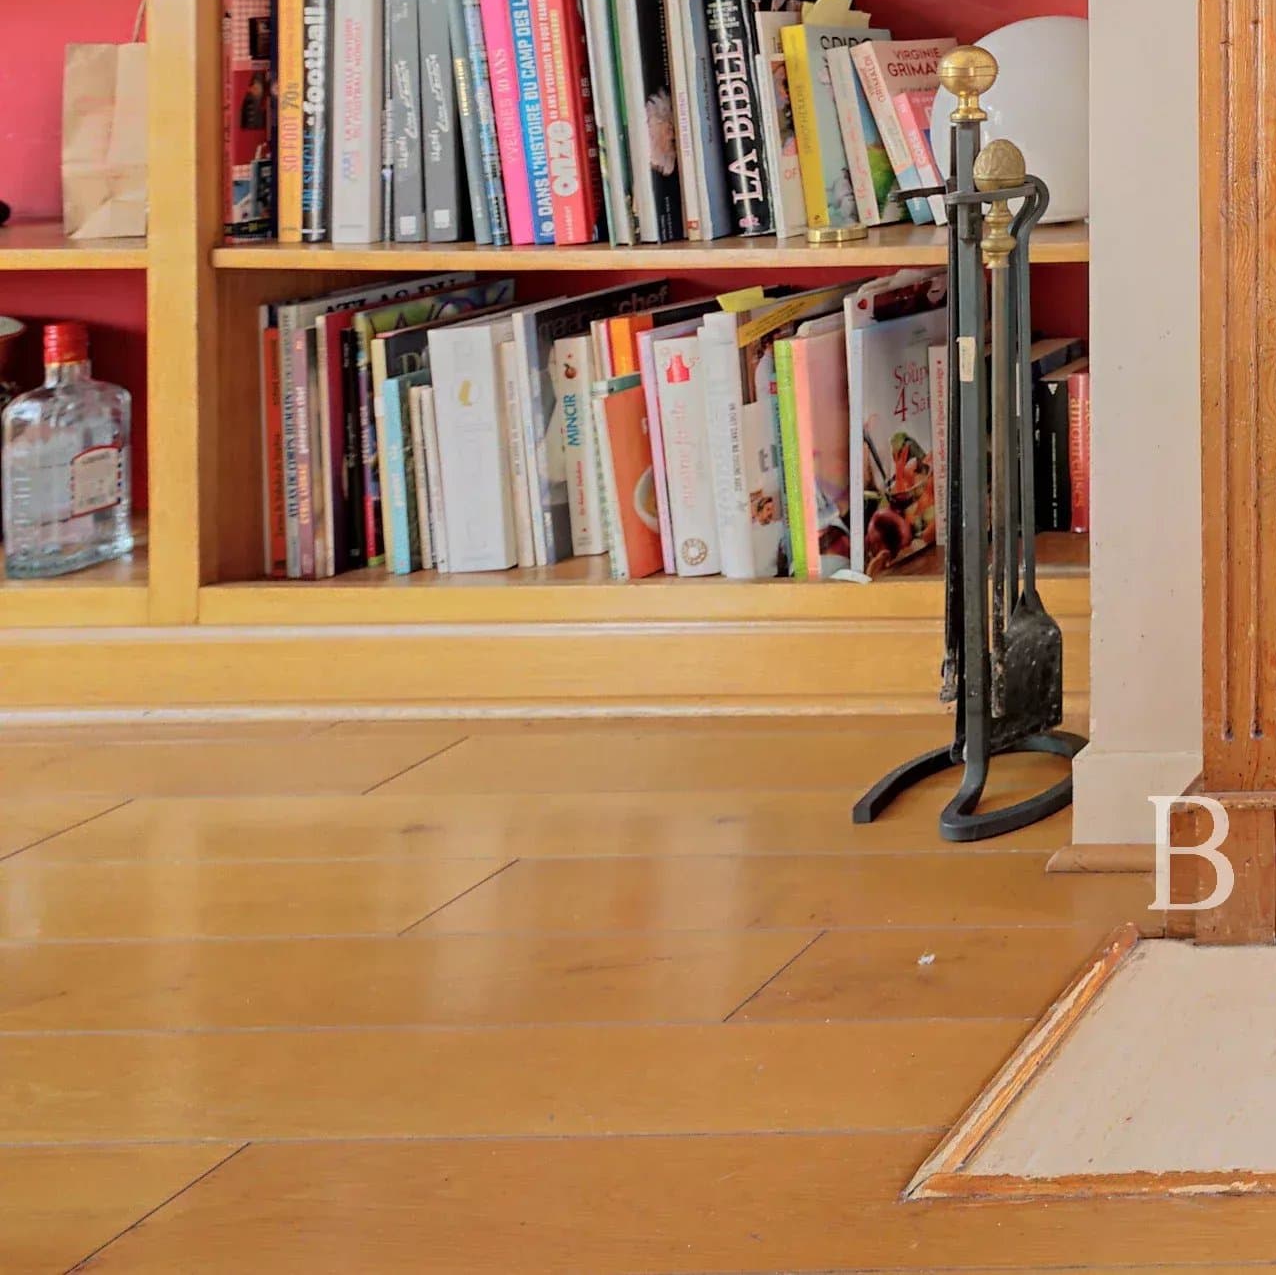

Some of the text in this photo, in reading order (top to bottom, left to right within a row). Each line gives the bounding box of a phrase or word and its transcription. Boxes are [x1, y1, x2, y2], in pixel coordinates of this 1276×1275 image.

[512, 11, 530, 37] DES
[303, 7, 326, 115] football
[494, 48, 510, 76] ANS
[517, 41, 535, 79] CAMP
[886, 60, 939, 78] GRIMA
[893, 47, 943, 61] VIRGINIE
[521, 82, 537, 101] DU
[711, 39, 756, 143] BIBLE
[280, 116, 298, 151] FOOT
[498, 98, 519, 164] YVELINES
[526, 105, 549, 176] L'HISTOIRE
[280, 155, 299, 173] SO
[547, 120, 579, 197] onze
[728, 149, 764, 204] LA
[536, 179, 553, 216] DANS
[563, 394, 581, 447] MINCIR
[893, 386, 908, 422] 4
